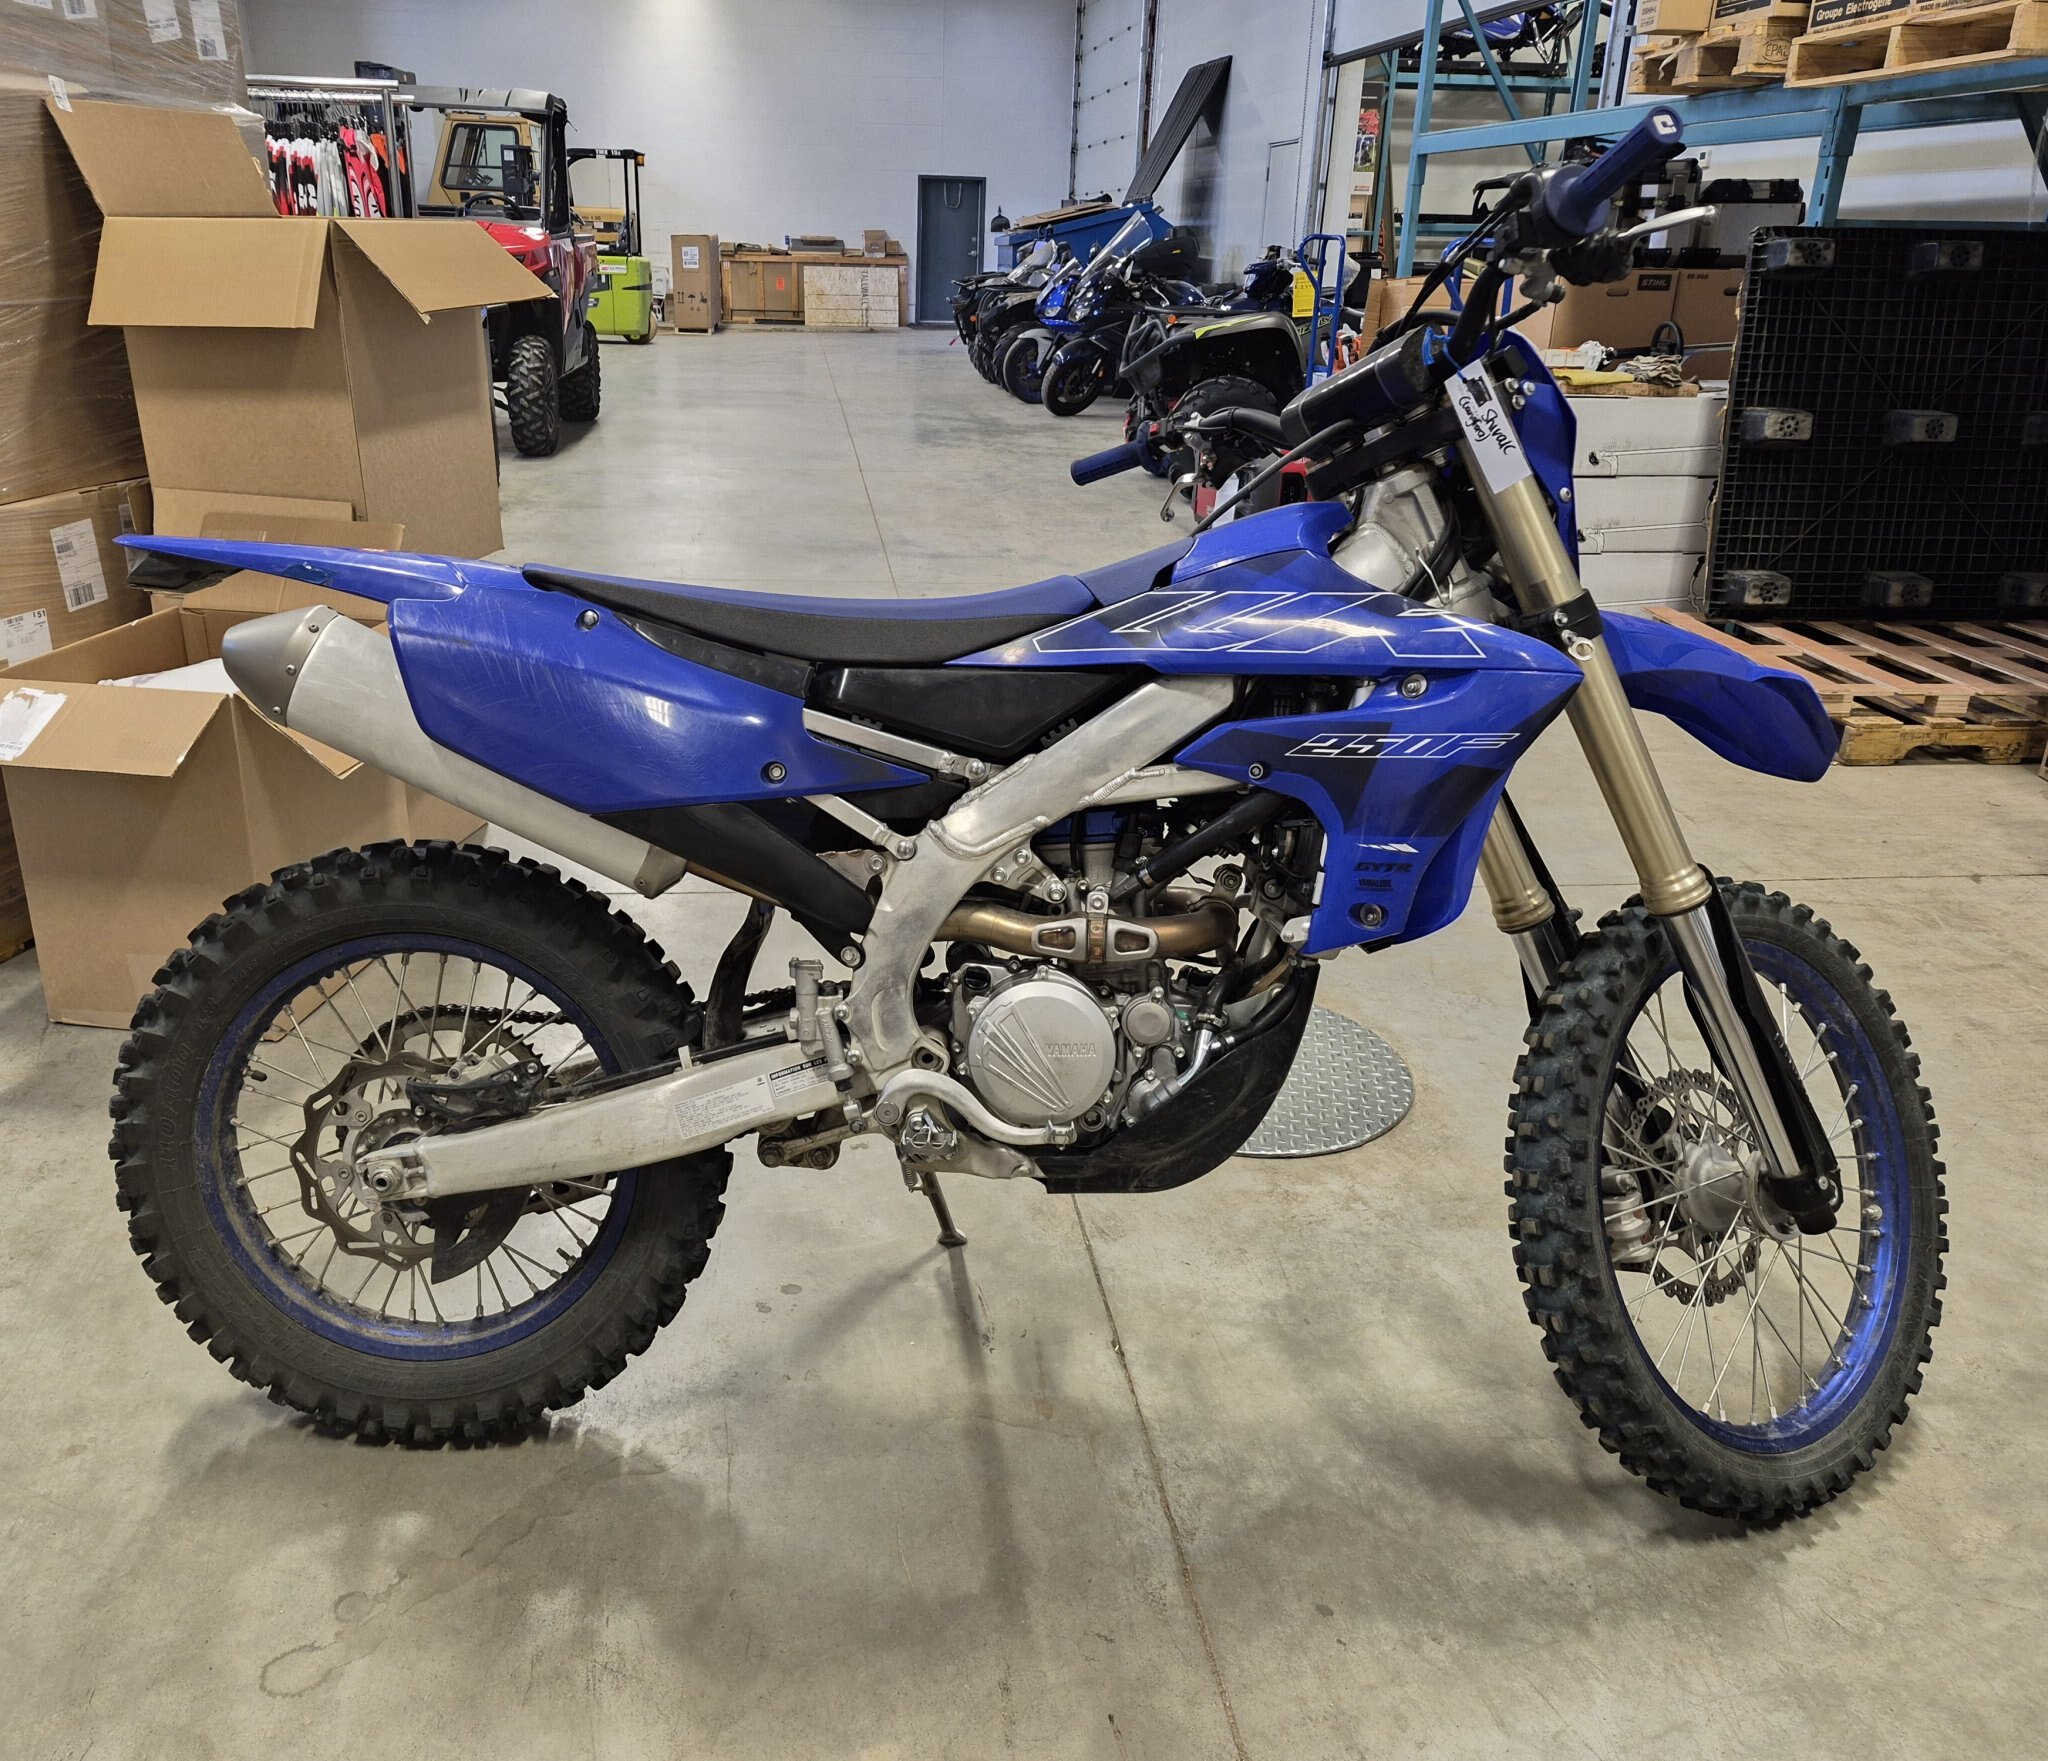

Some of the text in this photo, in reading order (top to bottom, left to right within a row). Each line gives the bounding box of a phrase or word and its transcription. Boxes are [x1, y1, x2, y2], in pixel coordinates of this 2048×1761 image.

[1816, 7, 1844, 21] Groupe
[1641, 279, 1667, 287] STIHL
[1284, 733, 1520, 759] 250F
[1046, 1042, 1097, 1058] YAMAHA
